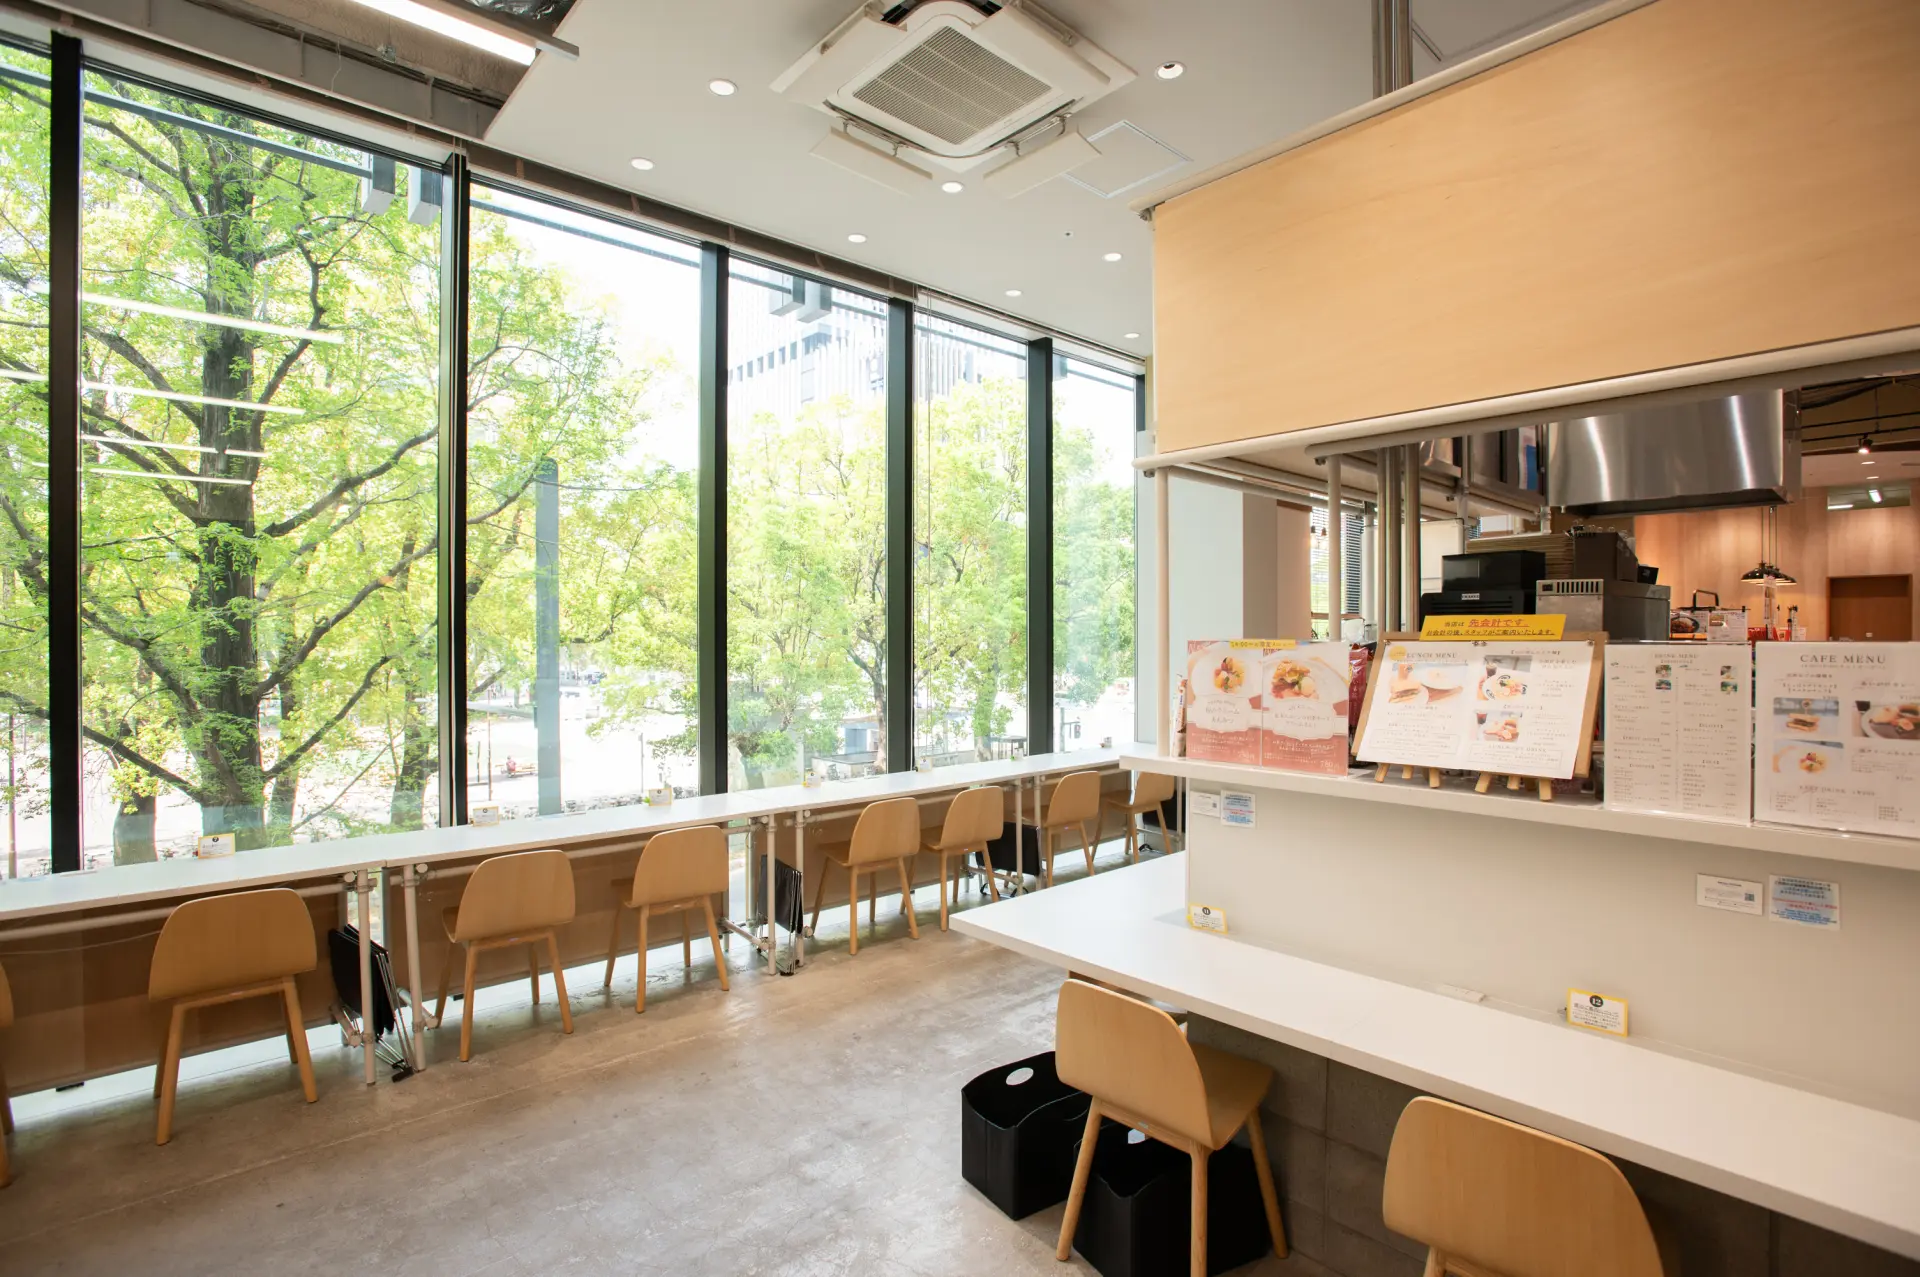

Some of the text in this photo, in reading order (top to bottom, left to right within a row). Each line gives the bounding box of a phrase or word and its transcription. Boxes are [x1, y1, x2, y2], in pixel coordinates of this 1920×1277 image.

[1468, 618, 1530, 628] 先会計です。
[1800, 654, 1886, 664] CAFE MENU
